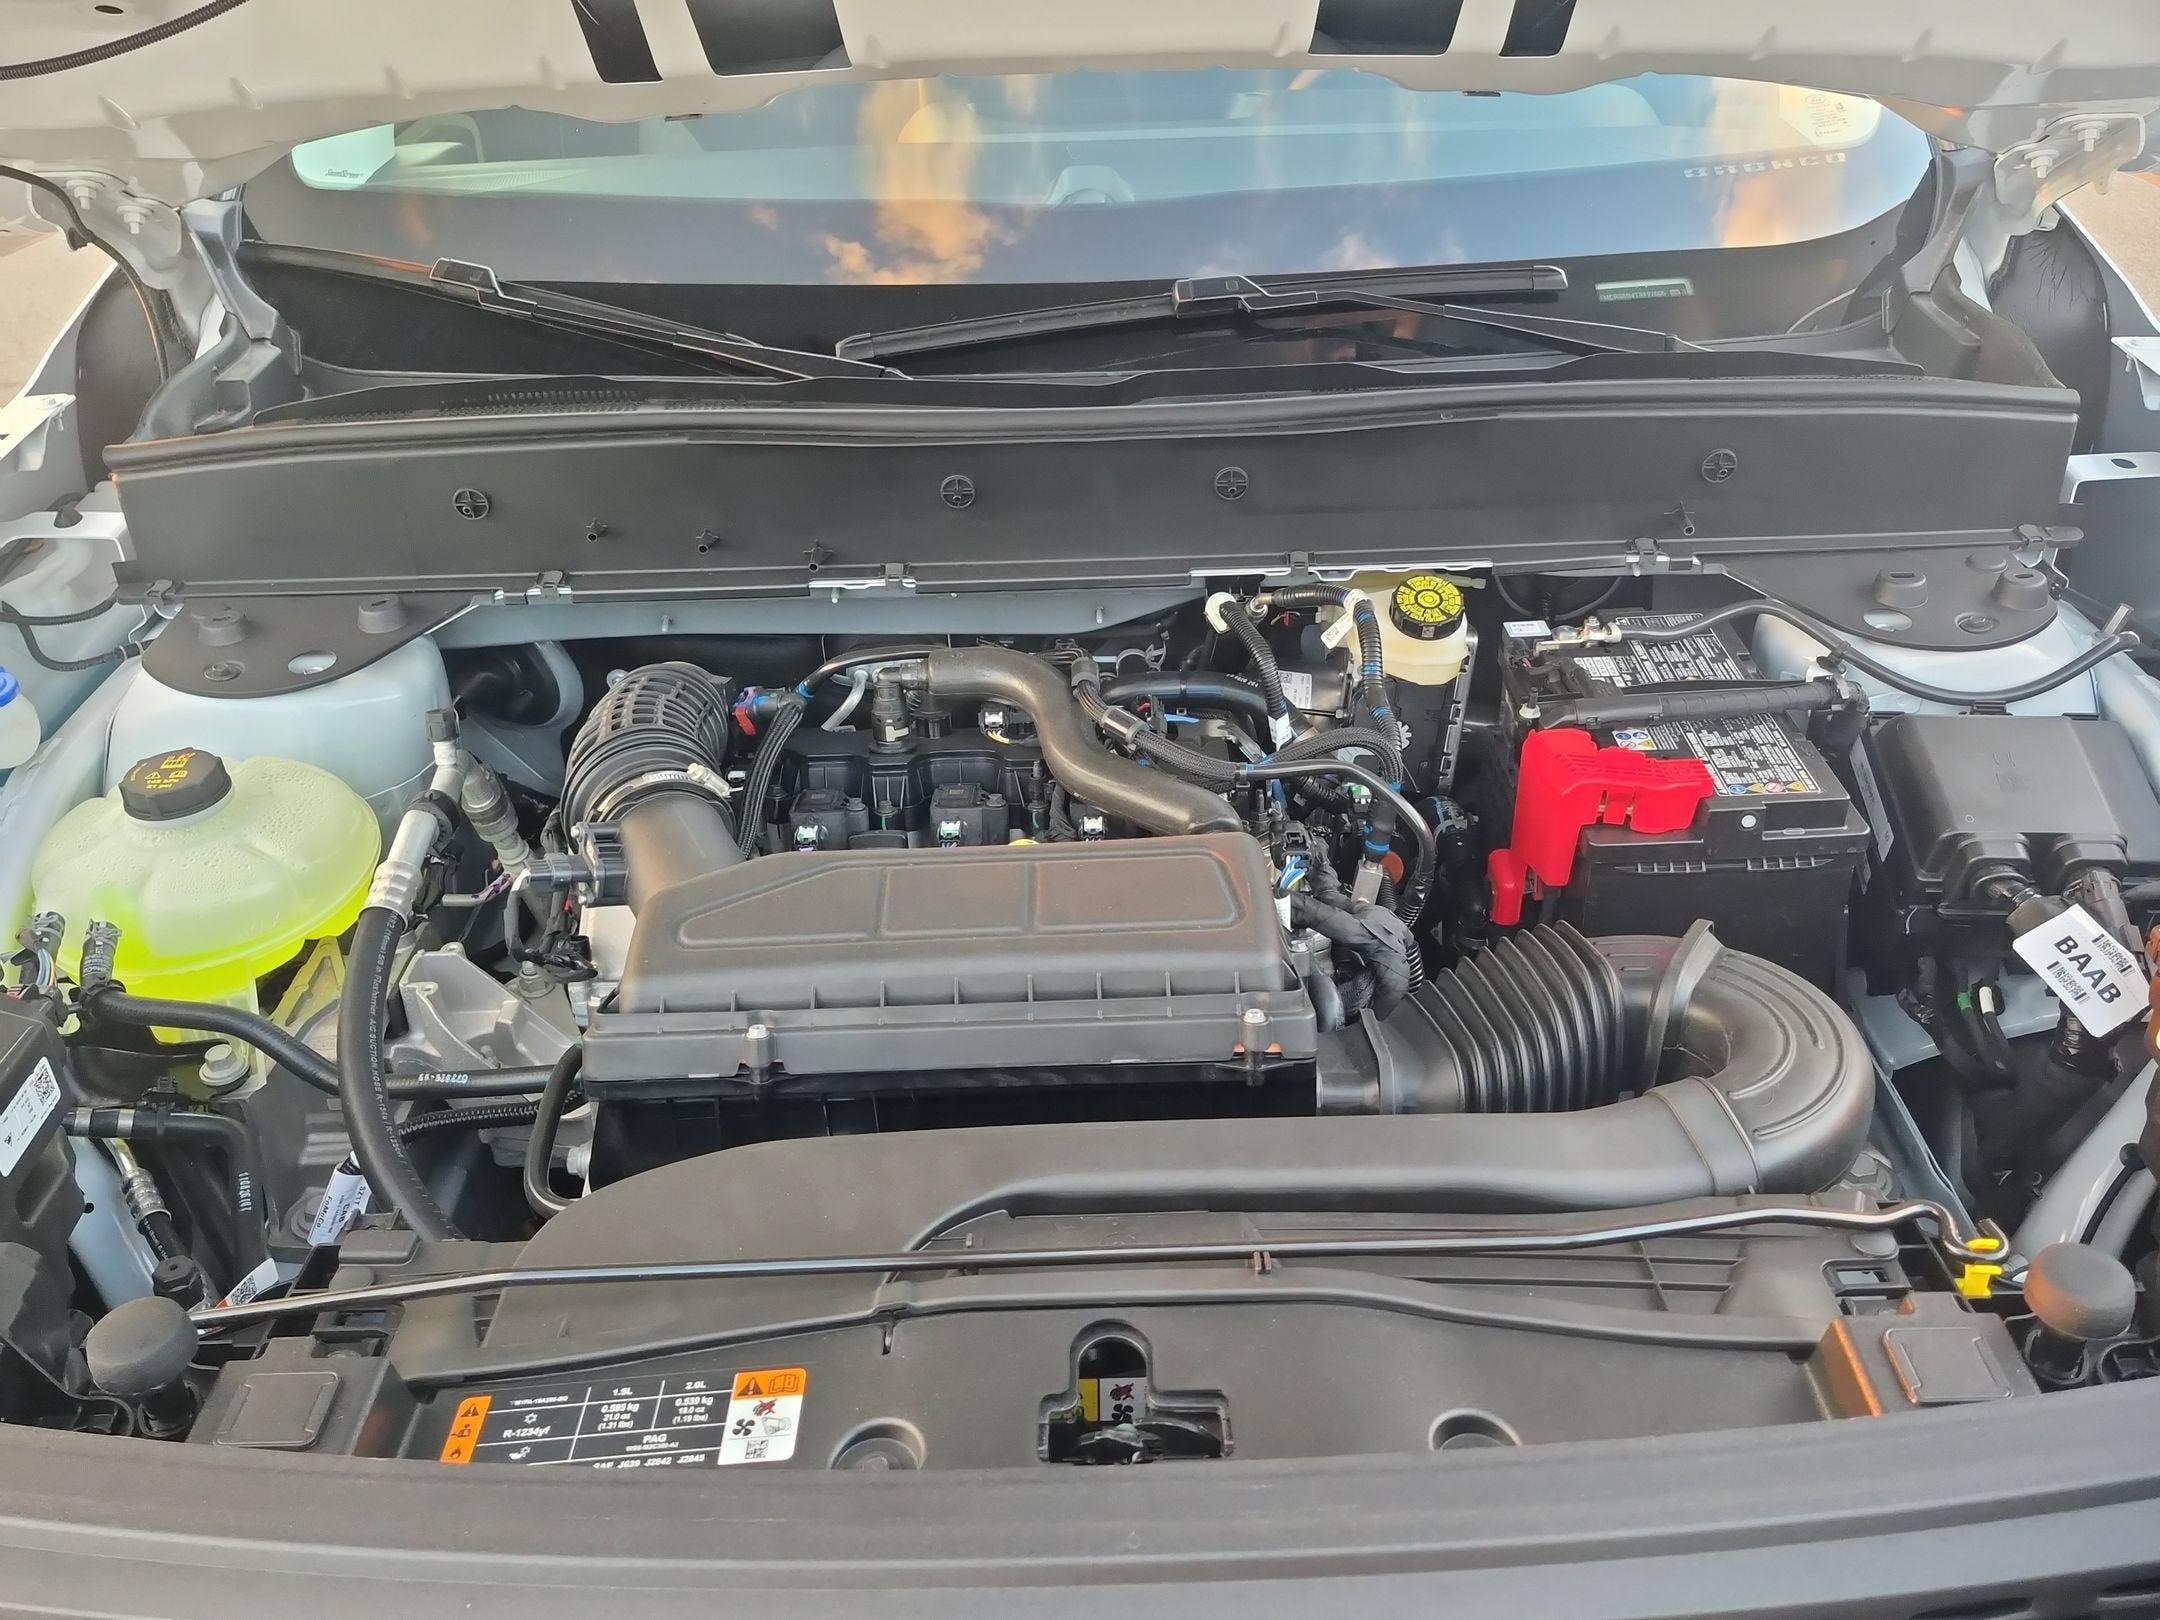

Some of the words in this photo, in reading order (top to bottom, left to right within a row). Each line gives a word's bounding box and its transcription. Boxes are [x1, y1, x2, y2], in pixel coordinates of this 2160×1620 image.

[2054, 935, 2122, 1004] BAAB
[684, 1380, 707, 1390] 2.0L
[701, 1396, 714, 1405] kg
[627, 1402, 640, 1412] kg
[502, 1425, 551, 1438] R-1234yf
[642, 1433, 667, 1444] PAG
